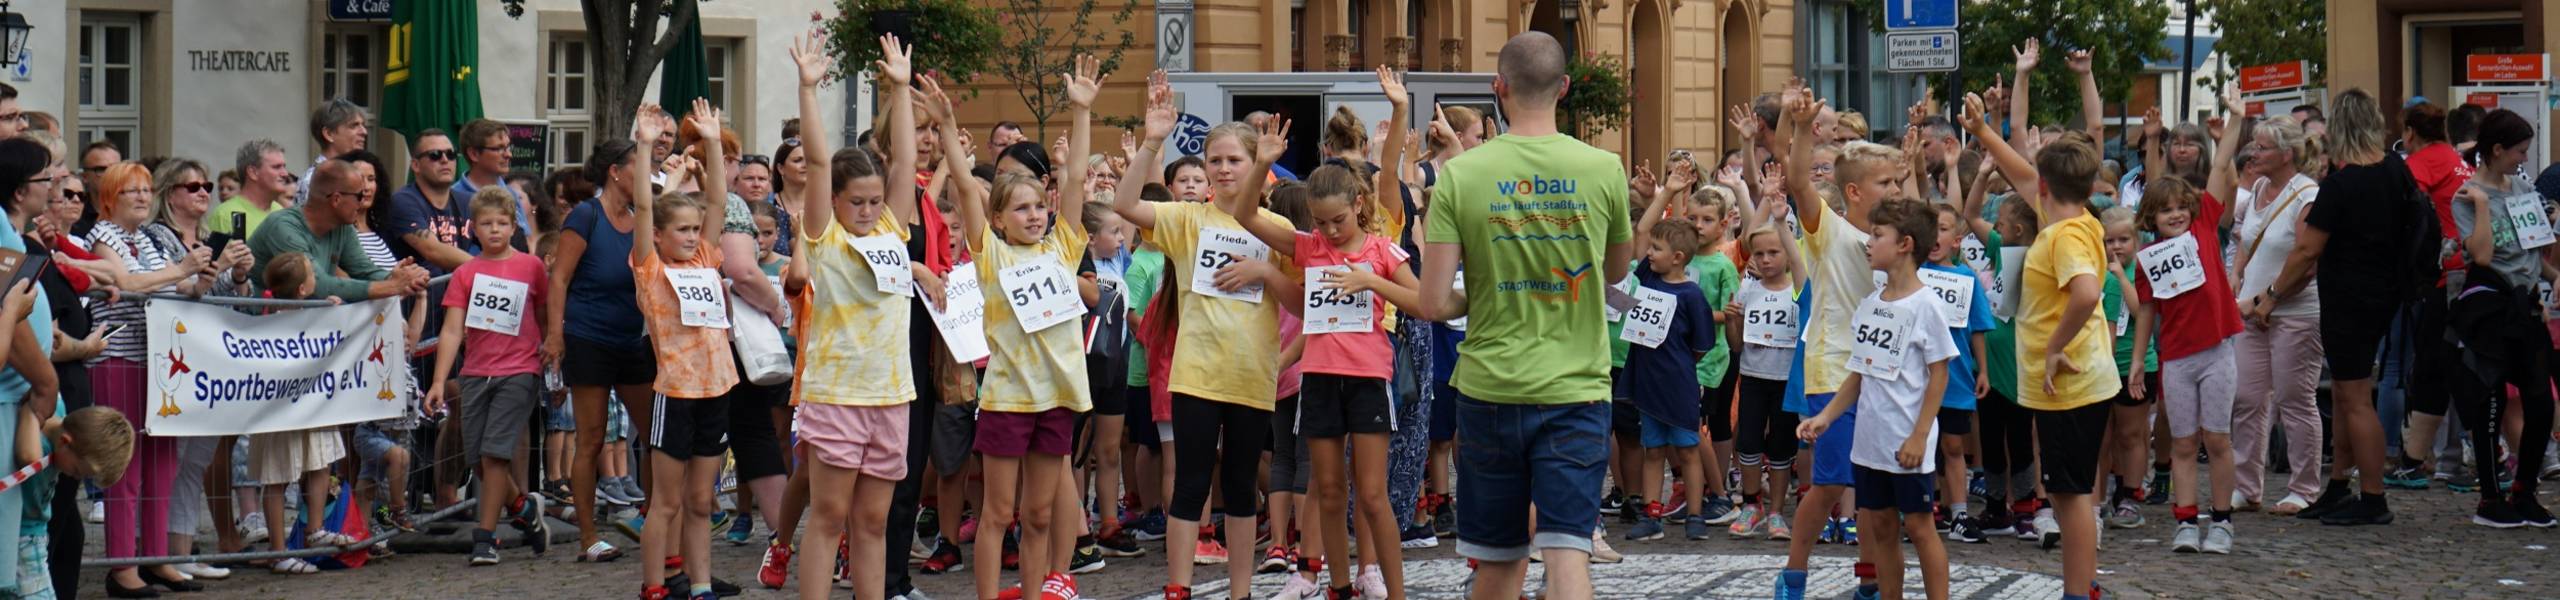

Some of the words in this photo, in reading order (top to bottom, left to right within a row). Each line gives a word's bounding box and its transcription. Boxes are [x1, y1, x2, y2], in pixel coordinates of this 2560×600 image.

[1892, 38, 1917, 47] Parken
[1920, 37, 1932, 46] mit
[1943, 37, 1951, 45] in
[188, 50, 290, 72] THEATERCAFE
[1890, 48, 1953, 59] gekennzeichneten
[1897, 58, 1925, 67] Flächen
[1497, 174, 1576, 195] wobau
[1490, 202, 1511, 213] hier
[1514, 201, 1540, 211] läuft
[1543, 200, 1588, 212] Staßfurt
[1215, 233, 1248, 245] Frieda
[865, 249, 901, 266] 660
[1962, 247, 1986, 261] 37
[2149, 242, 2176, 258] Leonie
[1015, 264, 1041, 278] Erika
[2149, 254, 2184, 282] 546
[1497, 279, 1567, 293] STADTWERKE
[1928, 273, 1958, 284] Konrad
[678, 286, 714, 303] 588
[1011, 276, 1057, 307] 511
[1928, 284, 1957, 304] 36
[473, 292, 511, 312] 582
[1630, 305, 1662, 325] 555
[1748, 309, 1787, 325] 512
[1856, 324, 1893, 350] 542
[193, 370, 335, 409] Sportbewegung
[340, 360, 368, 391] e.V.
